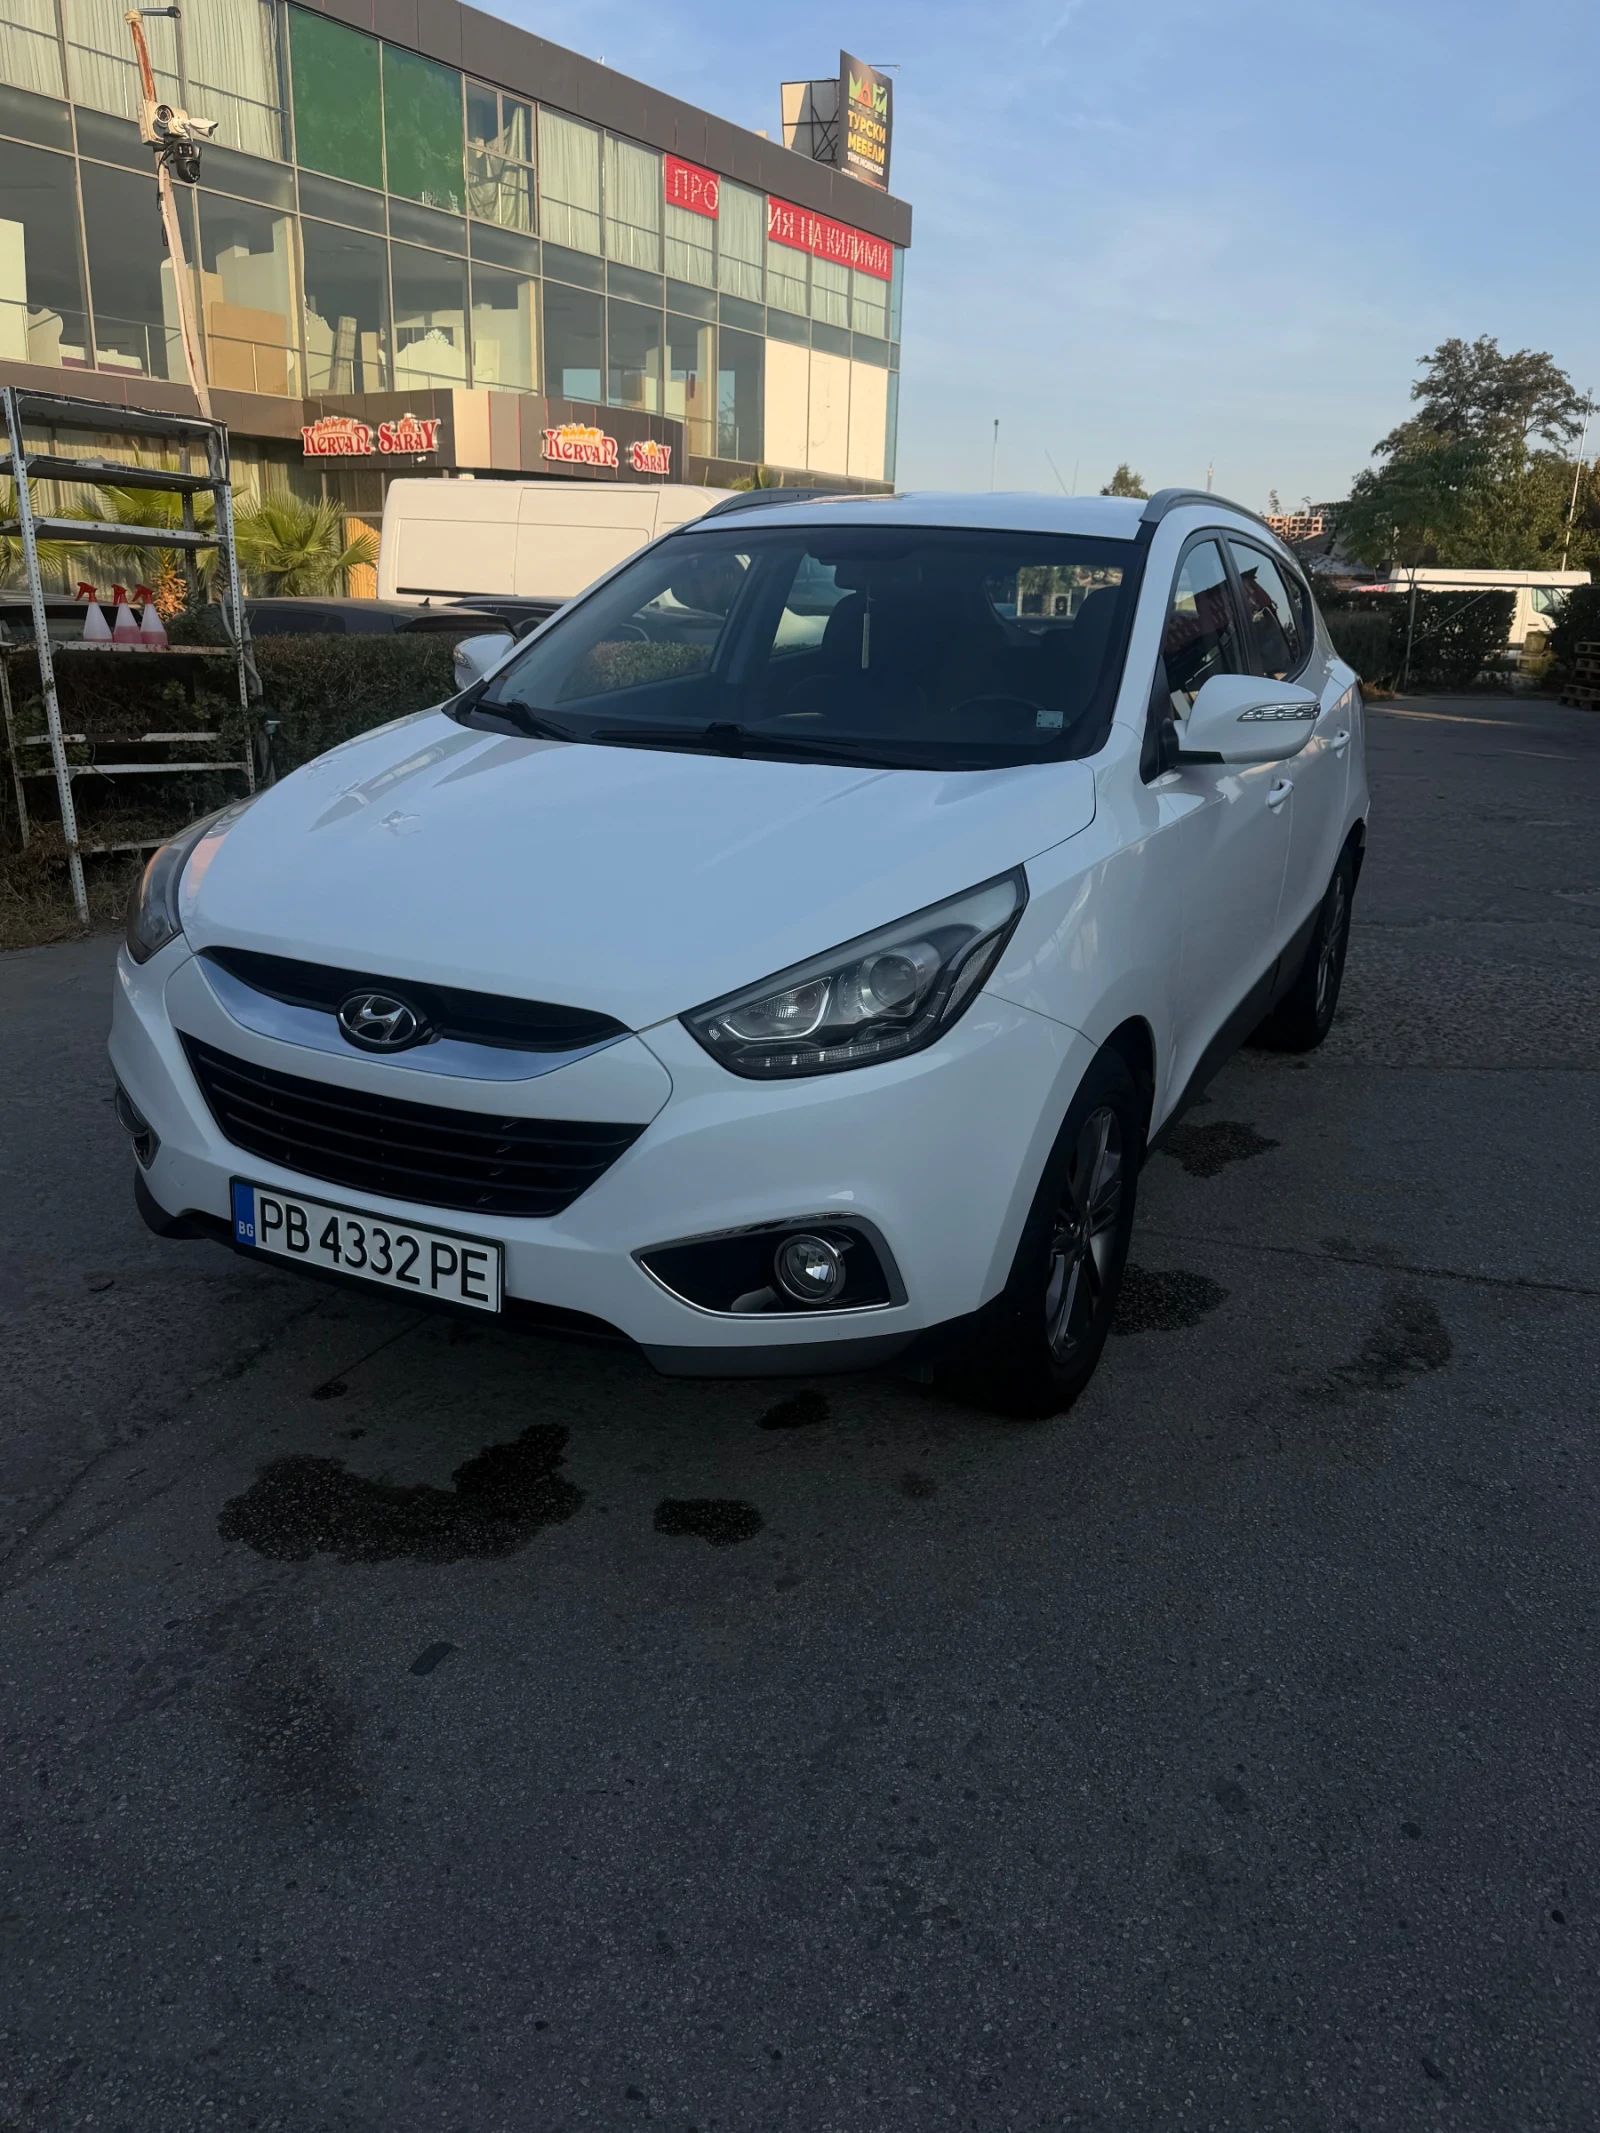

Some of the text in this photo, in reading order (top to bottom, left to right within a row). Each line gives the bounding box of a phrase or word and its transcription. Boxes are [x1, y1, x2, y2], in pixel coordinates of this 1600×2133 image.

[847, 109, 886, 144] ТУРСКИ
[847, 131, 885, 165] МЕБЕЛИ
[674, 168, 719, 210] ПРО
[826, 226, 888, 273] КИЛИМИ
[378, 421, 438, 453] SARAY
[632, 442, 670, 473] SARAY
[238, 1220, 254, 1238] BG
[260, 1196, 489, 1302] PB 4332 PE
